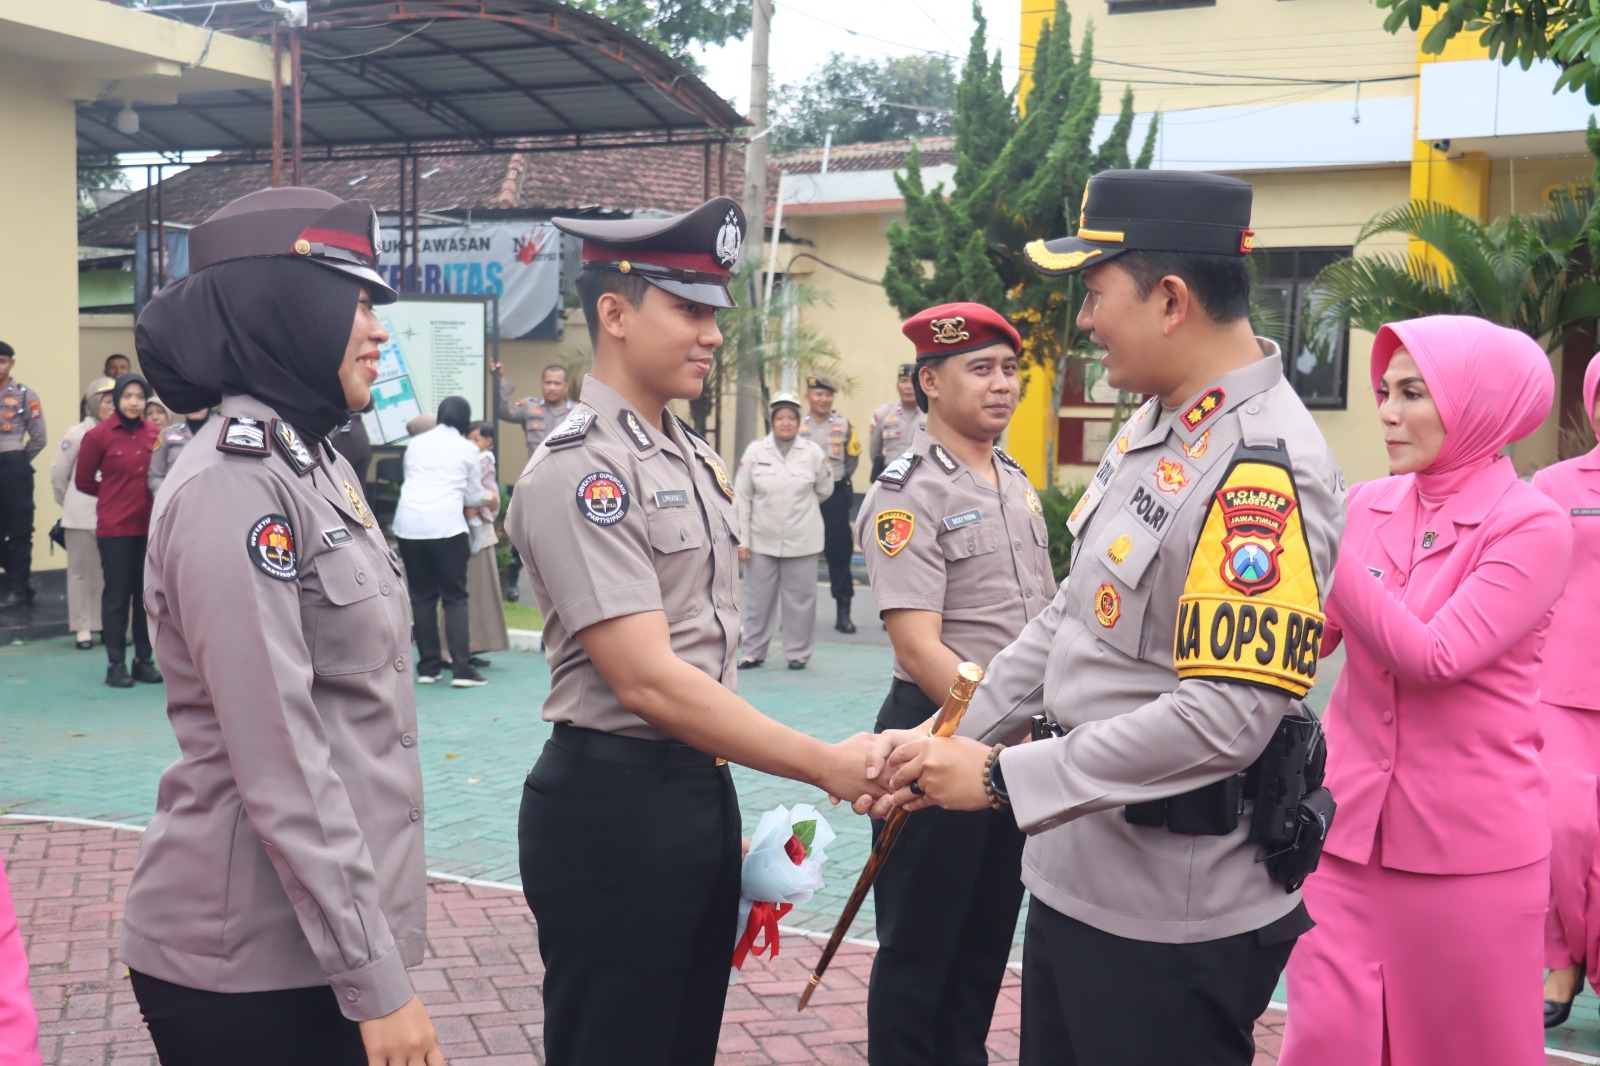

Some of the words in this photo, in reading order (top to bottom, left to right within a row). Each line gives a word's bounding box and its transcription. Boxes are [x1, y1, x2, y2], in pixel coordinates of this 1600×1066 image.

[578, 474, 597, 497] OBYEKTIF
[600, 473, 627, 496] DIPERCAYA
[1226, 490, 1286, 506] POLRES
[1233, 498, 1279, 511] MAGETAN
[1129, 485, 1169, 532] POLRI
[586, 510, 625, 524] PARTISIPASI
[1230, 515, 1254, 524] JAWA
[1255, 516, 1280, 530] TIMUR
[1175, 601, 1200, 661] KA
[1210, 602, 1278, 666] OPS
[1282, 611, 1324, 679] RES
